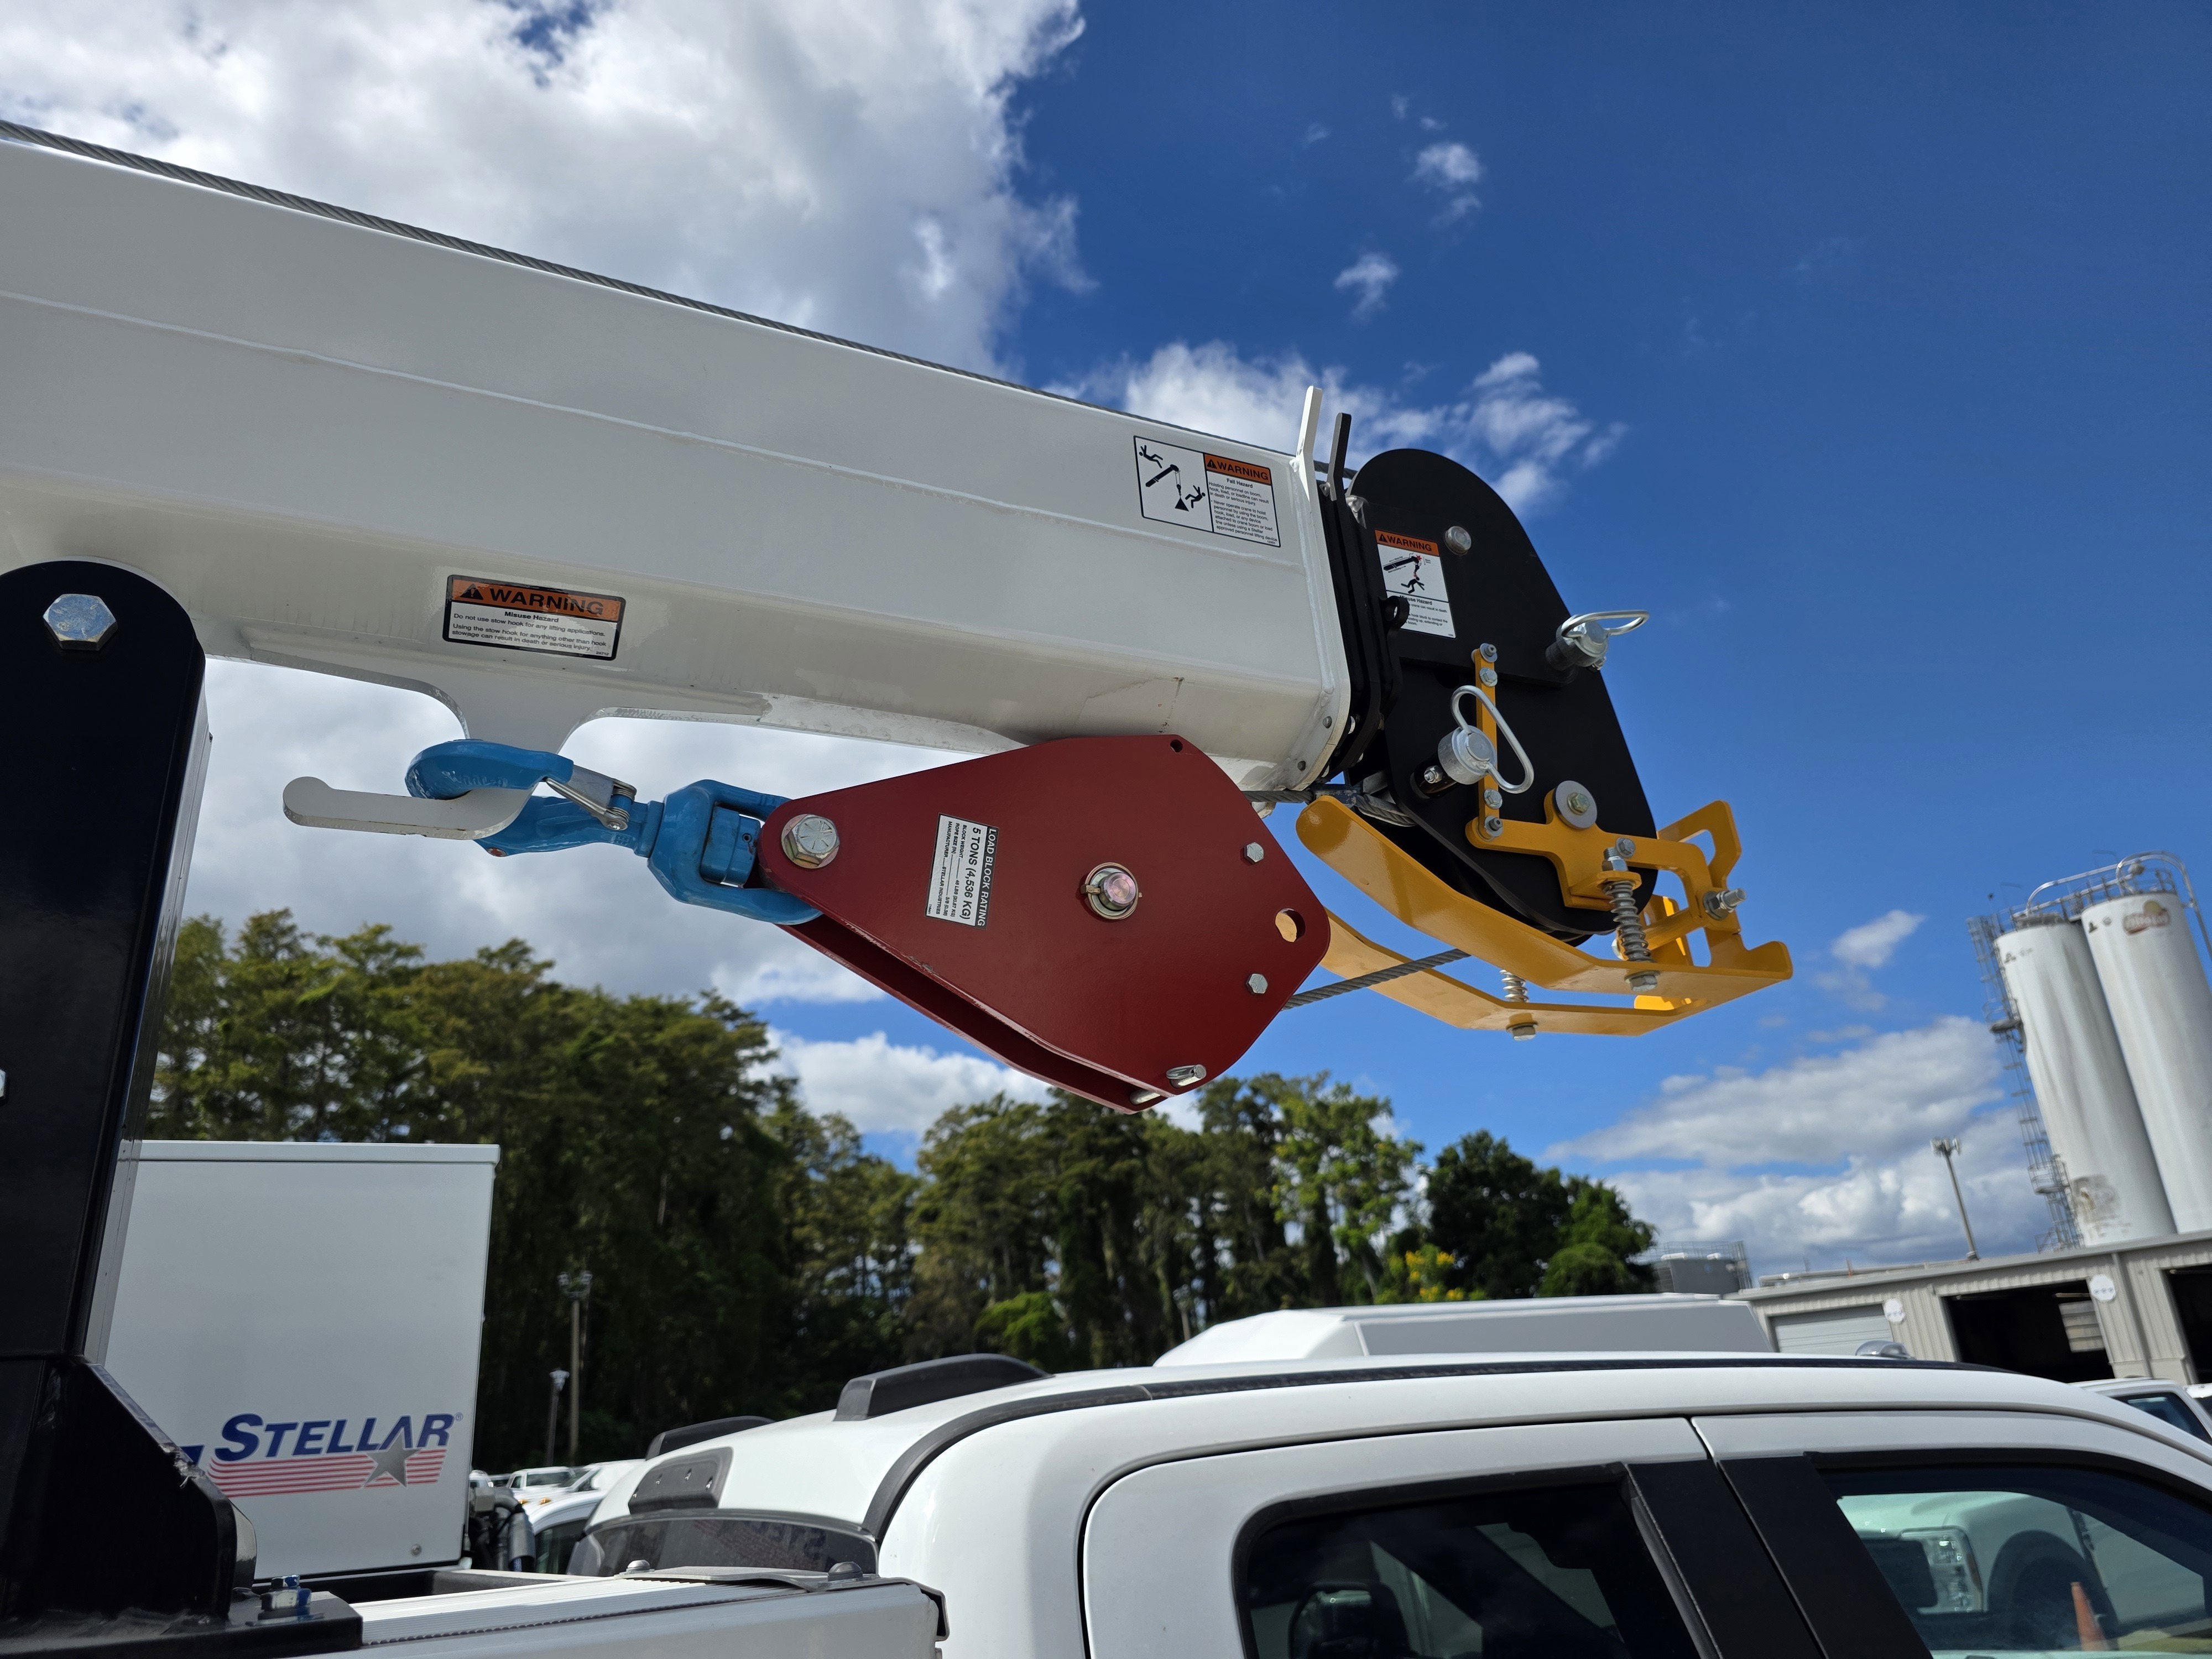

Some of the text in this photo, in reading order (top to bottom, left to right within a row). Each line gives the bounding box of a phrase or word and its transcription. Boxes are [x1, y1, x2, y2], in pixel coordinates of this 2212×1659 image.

[1217, 461, 1268, 480] WARNING
[1386, 535, 1432, 551] WARNING
[488, 587, 604, 615] WARNING
[529, 633, 556, 641] anything
[567, 628, 606, 637] applications.
[943, 821, 952, 857] MANUFACTURER
[968, 835, 980, 865] TONS
[962, 867, 976, 898] (4,536
[977, 828, 996, 926] LOAD BLOCK RATING
[959, 900, 972, 920] KG)
[215, 1413, 455, 1462] STELLAR
